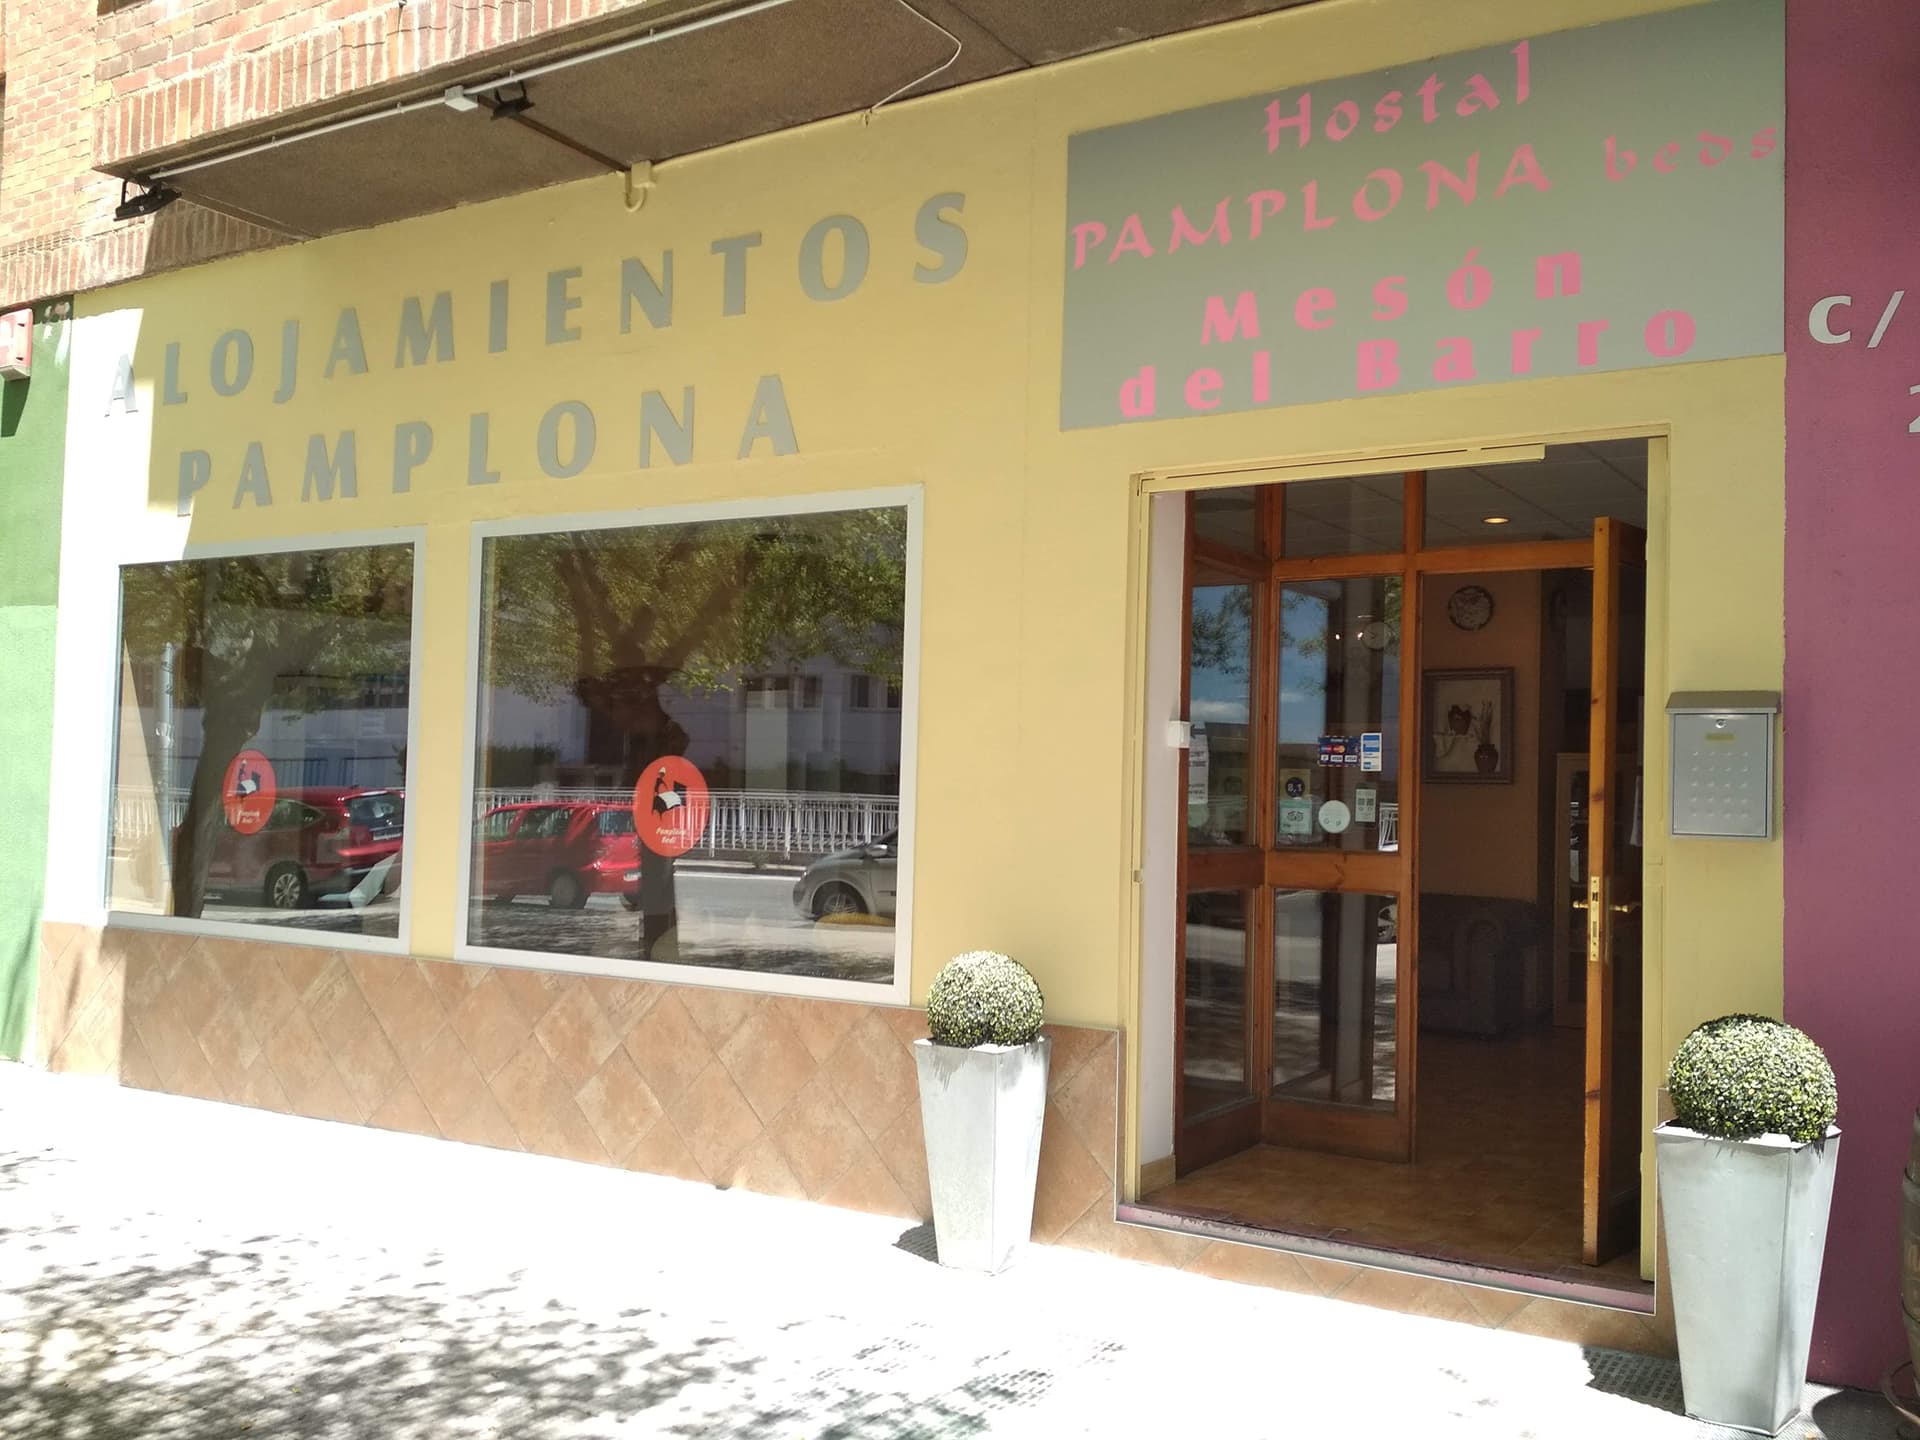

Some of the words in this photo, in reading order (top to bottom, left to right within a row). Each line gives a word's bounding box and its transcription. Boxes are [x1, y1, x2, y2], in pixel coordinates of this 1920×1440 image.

[1262, 40, 1530, 154] Hostal
[1071, 144, 1553, 270] PAMPLONA
[1603, 124, 1777, 182] beds
[104, 191, 969, 418] ALOJAMIENTOS
[1201, 248, 1582, 345] Mesón
[1119, 350, 1271, 418] del
[1357, 309, 1697, 391] Barro
[177, 374, 799, 517] PAMPLONA
